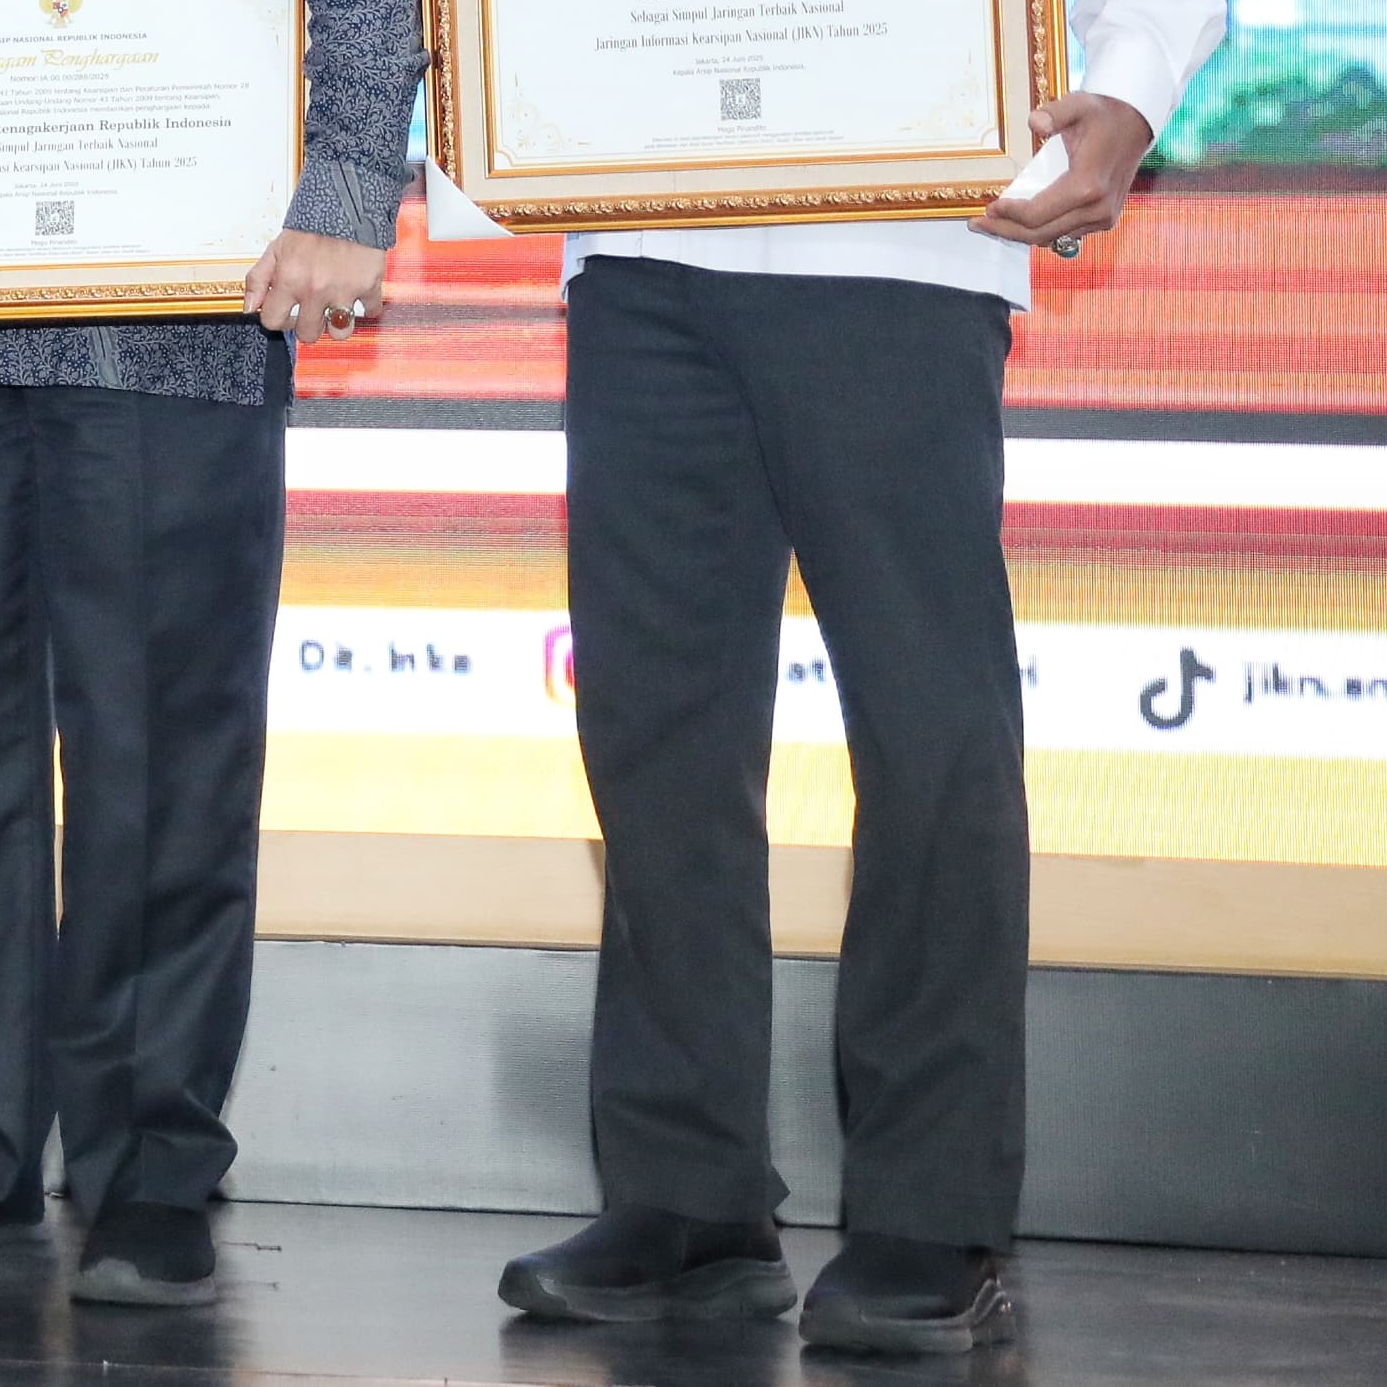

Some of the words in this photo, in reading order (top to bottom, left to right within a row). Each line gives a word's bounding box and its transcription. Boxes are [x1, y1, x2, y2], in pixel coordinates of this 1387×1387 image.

[630, 9, 669, 26] Sebagai
[672, 6, 708, 24] Simpul
[711, 5, 755, 21] Jaringan
[759, 2, 798, 17] Terbaik
[801, 0, 844, 14] Nasional
[12, 35, 54, 44] NASIONAL
[56, 34, 98, 42] REPUBLIK
[100, 32, 148, 41] INDONESIA
[594, 37, 638, 52] Jaringan
[641, 34, 689, 48] Informasi
[692, 31, 742, 47] Kearsipan
[745, 27, 788, 42] Nasional
[826, 24, 859, 38] Tahun
[862, 22, 888, 36] 2025
[40, 48, 159, 72] Penghargaan
[99, 118, 160, 133] Republik
[165, 116, 231, 129] Indonesia
